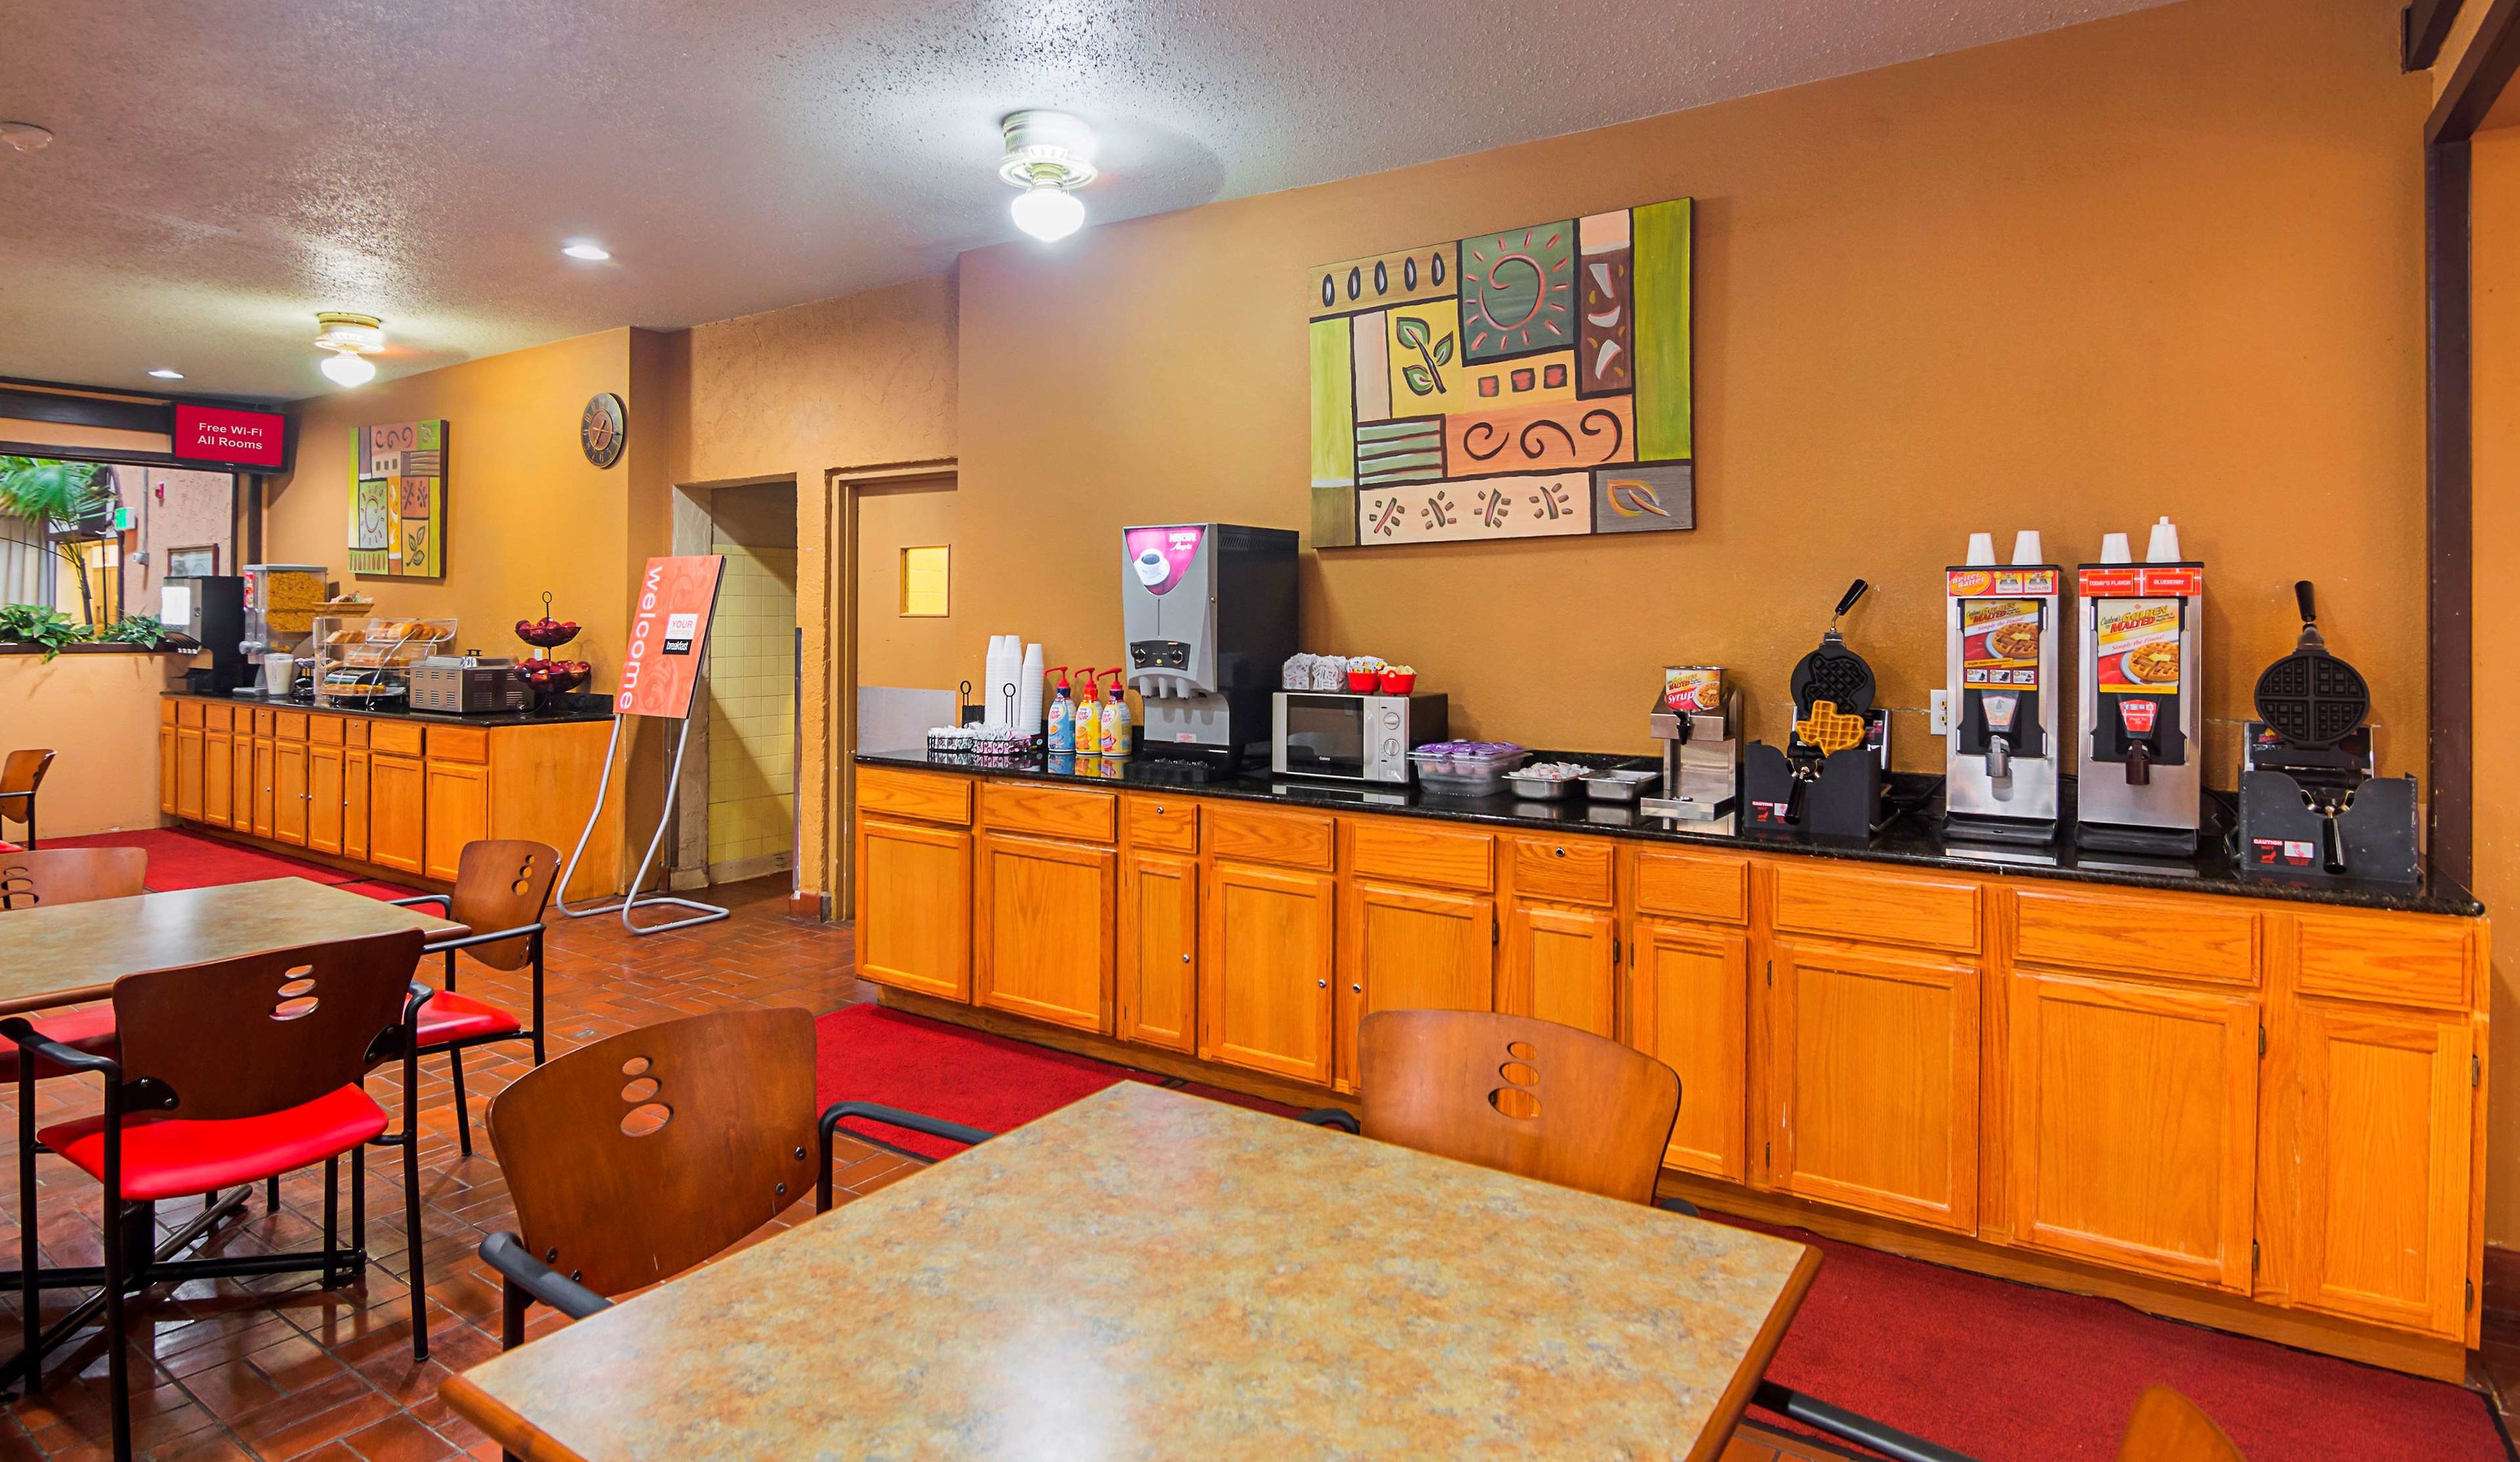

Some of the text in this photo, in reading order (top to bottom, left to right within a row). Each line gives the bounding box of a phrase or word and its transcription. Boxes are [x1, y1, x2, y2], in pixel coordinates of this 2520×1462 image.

[199, 422, 263, 437] Free Wi-Fi
[198, 435, 263, 449] All Rooms
[1973, 611, 2006, 623] MALTED
[2121, 606, 2168, 623] GOLDEN
[672, 620, 693, 628] YOUR
[2111, 617, 2155, 633] MALTED
[620, 566, 662, 709] welcome
[666, 640, 688, 650] breakfast
[1668, 691, 1694, 704] Syrup
